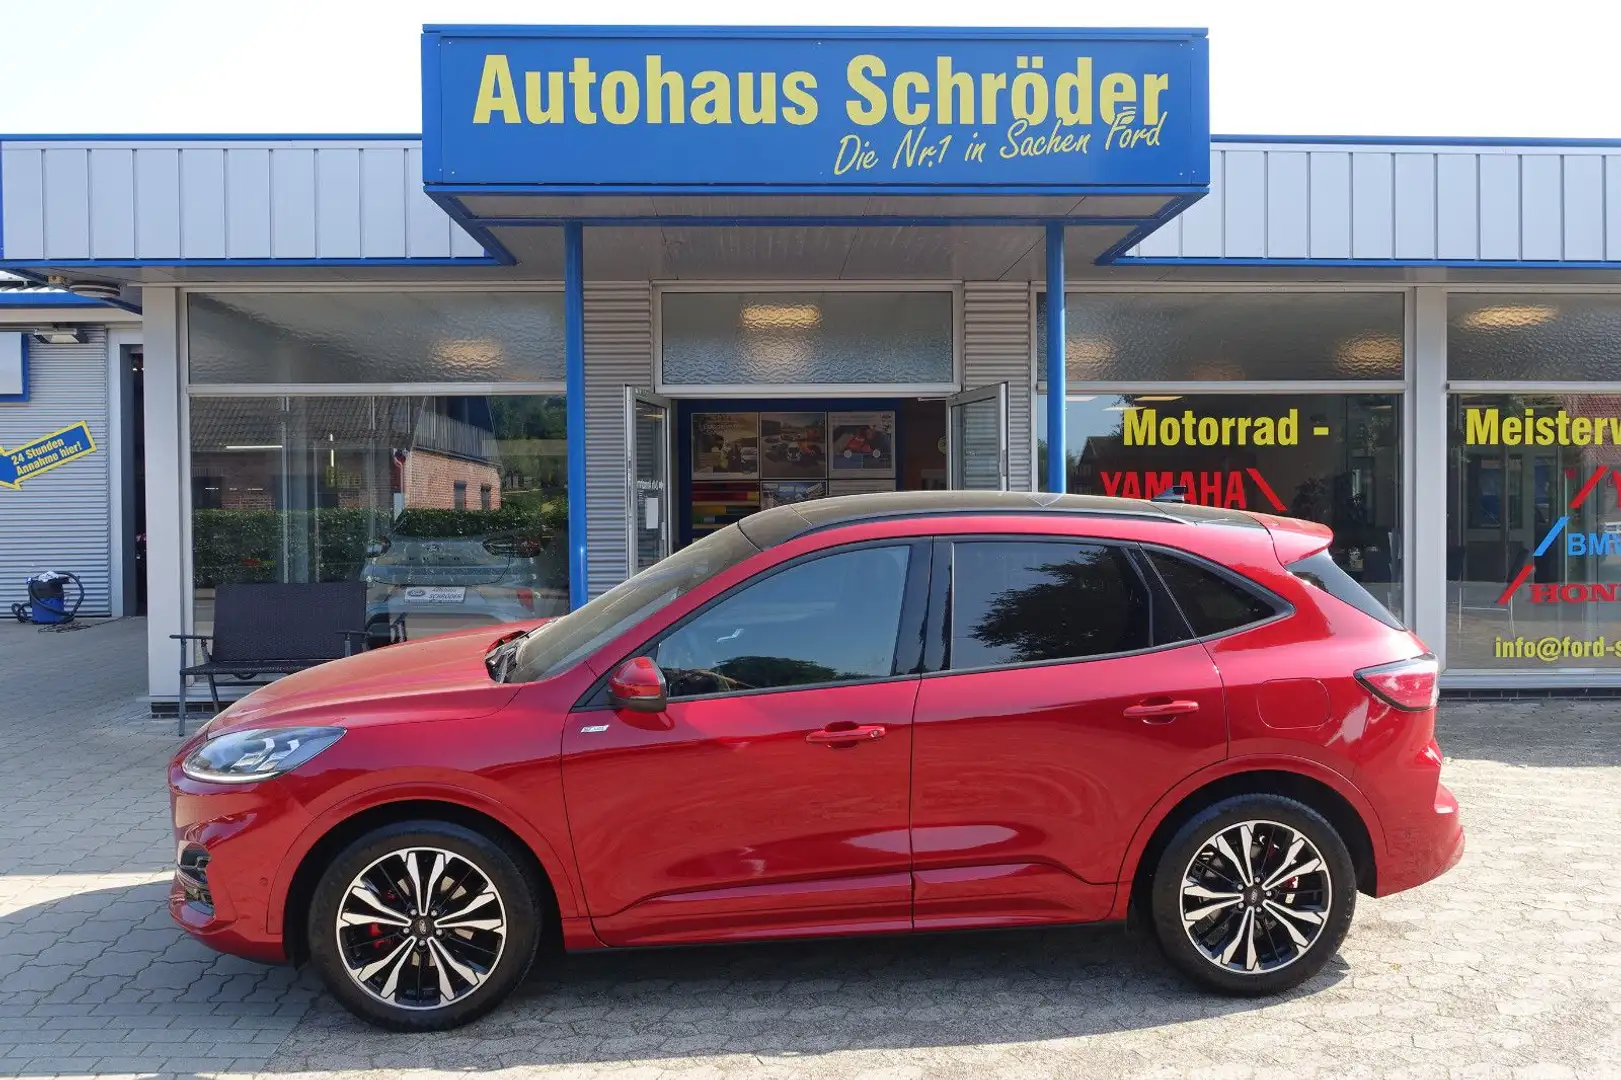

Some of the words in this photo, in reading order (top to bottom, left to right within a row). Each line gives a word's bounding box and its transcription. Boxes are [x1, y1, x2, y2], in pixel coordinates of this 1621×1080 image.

[472, 54, 818, 126] Autohaus
[846, 54, 1169, 126] Schröder
[834, 134, 878, 175] Die
[893, 127, 952, 169] Nr.1
[964, 133, 983, 163] in
[1000, 118, 1092, 158] Sachen
[1105, 106, 1168, 151] Ford
[1123, 408, 1298, 446] Motorrad
[11, 453, 25, 465] 24
[25, 438, 65, 459] Stunden
[15, 452, 59, 476] Annahme
[59, 441, 83, 458] hier!
[1100, 471, 1247, 509] YAMAHA
[1529, 583, 1621, 603] HON
